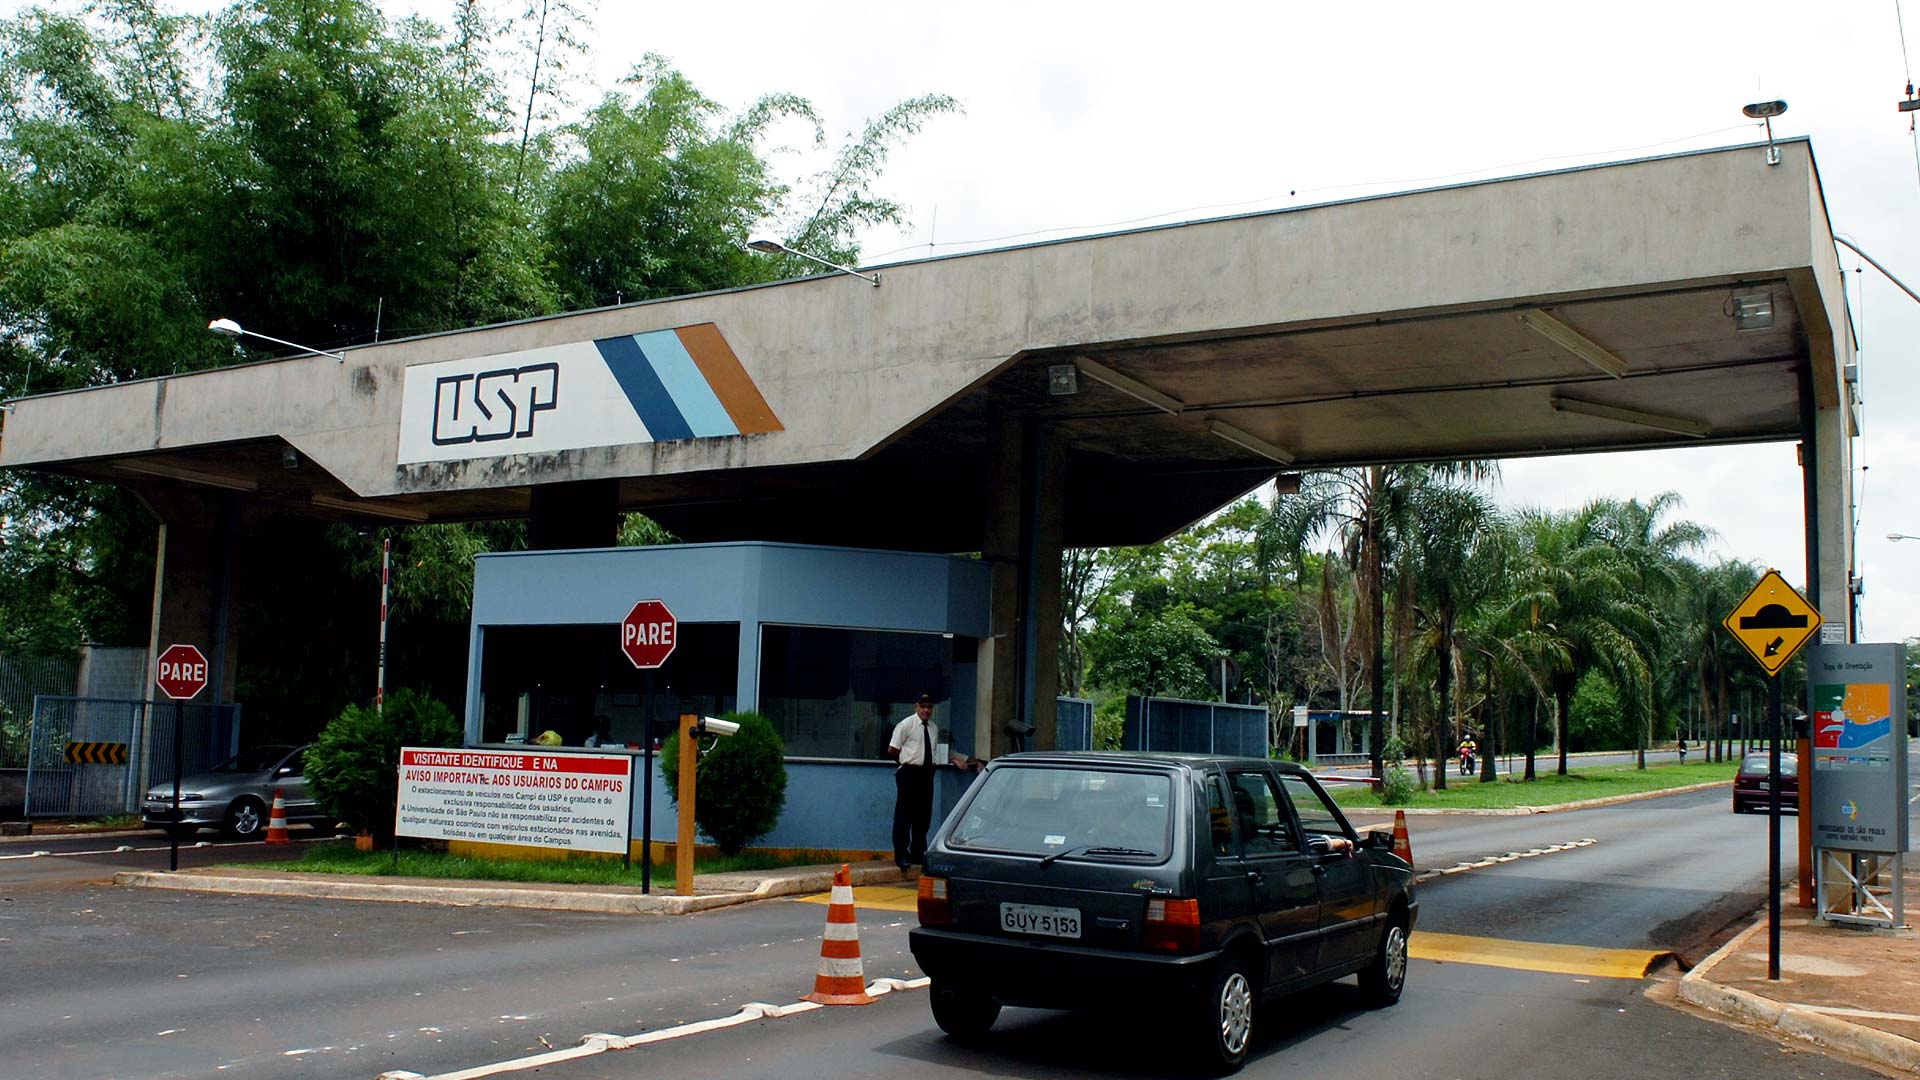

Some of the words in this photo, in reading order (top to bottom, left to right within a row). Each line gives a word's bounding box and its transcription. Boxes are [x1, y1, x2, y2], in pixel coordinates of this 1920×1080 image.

[432, 362, 559, 446] USP
[626, 622, 672, 646] PARE
[160, 662, 204, 681] PARE
[413, 753, 460, 766] VISITANTE
[462, 755, 523, 769] IDENTIFIQUE
[533, 758, 540, 769] E
[543, 758, 558, 770] NA
[406, 770, 431, 782] AVISO
[492, 774, 510, 786] AOS
[513, 773, 561, 789] USUÁRIOS
[564, 777, 578, 790] DO
[581, 778, 623, 793] CAMPUS
[418, 787, 465, 796] estacionamento
[516, 792, 536, 801] Campi
[547, 794, 562, 802] USP
[570, 796, 595, 805] gratuito
[407, 805, 445, 814] Universidade
[456, 808, 467, 816] São
[469, 809, 486, 817] Paulo
[510, 813, 557, 821] responsabiliza
[571, 816, 604, 825] acidentes
[474, 801, 527, 810] responsabilidade
[528, 803, 540, 811] dos
[402, 816, 427, 824] qualquer
[429, 818, 454, 826] natureza
[456, 820, 485, 828] ocorridos
[530, 826, 574, 834] estacionados
[488, 832, 517, 841] qualquer
[1005, 913, 1038, 930] GUY
[1042, 916, 1078, 933] 5153
